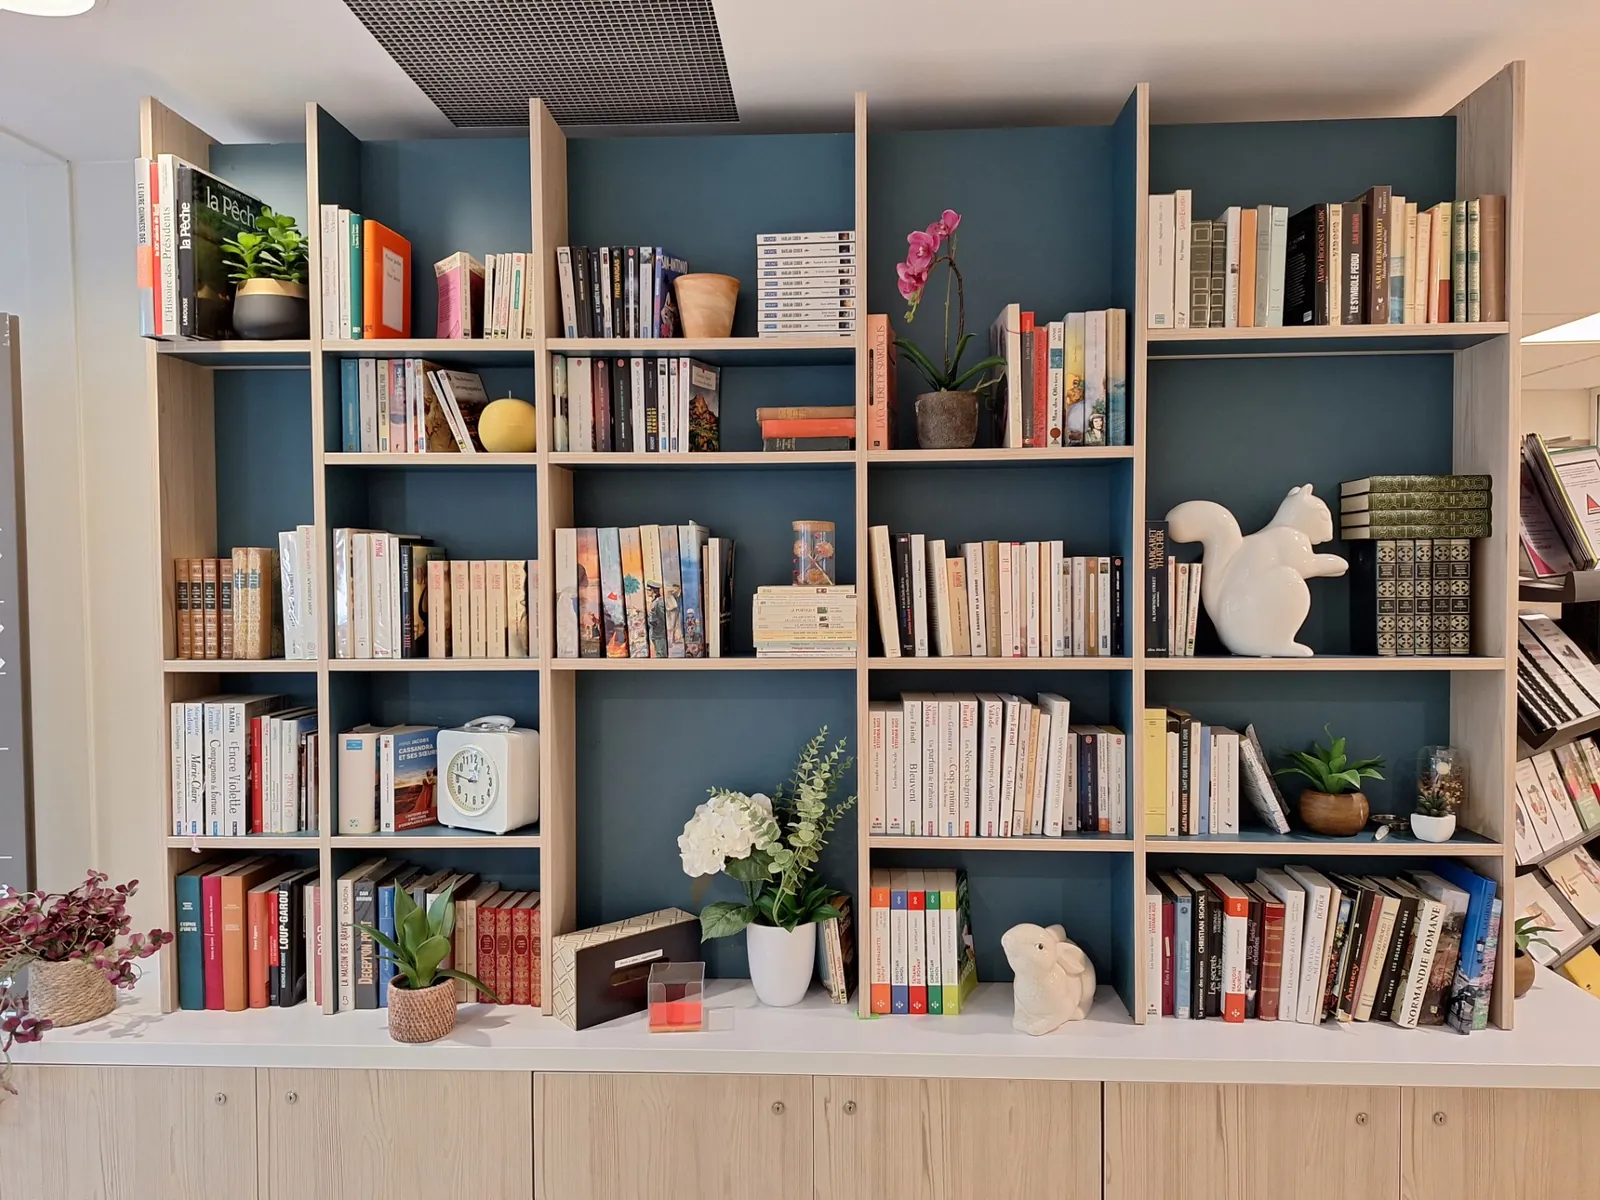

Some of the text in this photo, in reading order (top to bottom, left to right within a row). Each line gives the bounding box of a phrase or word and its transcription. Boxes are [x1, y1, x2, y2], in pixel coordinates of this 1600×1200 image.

[207, 186, 219, 212] la
[180, 202, 191, 249] la Pêche
[1317, 210, 1325, 283] MARY HIGGINS CLARK
[160, 207, 173, 322] L'Histoire des Présidents
[1350, 253, 1359, 314] LE SYMBOLE PERDU
[1156, 529, 1164, 568] THATCHER
[1009, 723, 1017, 746] Farnel
[399, 744, 433, 754] CASSANDRA
[462, 756, 468, 765] 11
[470, 754, 478, 763] 12
[456, 763, 463, 772] 10
[481, 757, 484, 766] 1
[487, 765, 490, 775] 2
[926, 749, 935, 775] parfum
[964, 750, 972, 773] Noces
[988, 745, 996, 778] Printemps
[191, 754, 201, 803] Marie-Claire
[208, 740, 221, 816] Compagnons fortune
[489, 778, 492, 787] 3
[909, 763, 917, 802] Bleuvent
[948, 764, 957, 784] Coqs
[228, 775, 240, 814] Violette
[458, 785, 461, 794] 8
[465, 793, 468, 802] 7
[472, 796, 476, 805] 6
[481, 795, 484, 804] 5
[487, 788, 490, 798] 4
[1317, 894, 1325, 919] DUFOUR
[279, 891, 288, 949] LOUP-GAROU
[1401, 909, 1409, 928] L'AUBE
[1399, 929, 1405, 937] DE
[358, 921, 373, 984] DECEPTION POT
[1393, 938, 1403, 961] SOLDATS
[1407, 906, 1441, 1025] NORMANDIE ROMANE
[1208, 982, 1216, 994] Les
[1344, 963, 1359, 1001] Annecy
